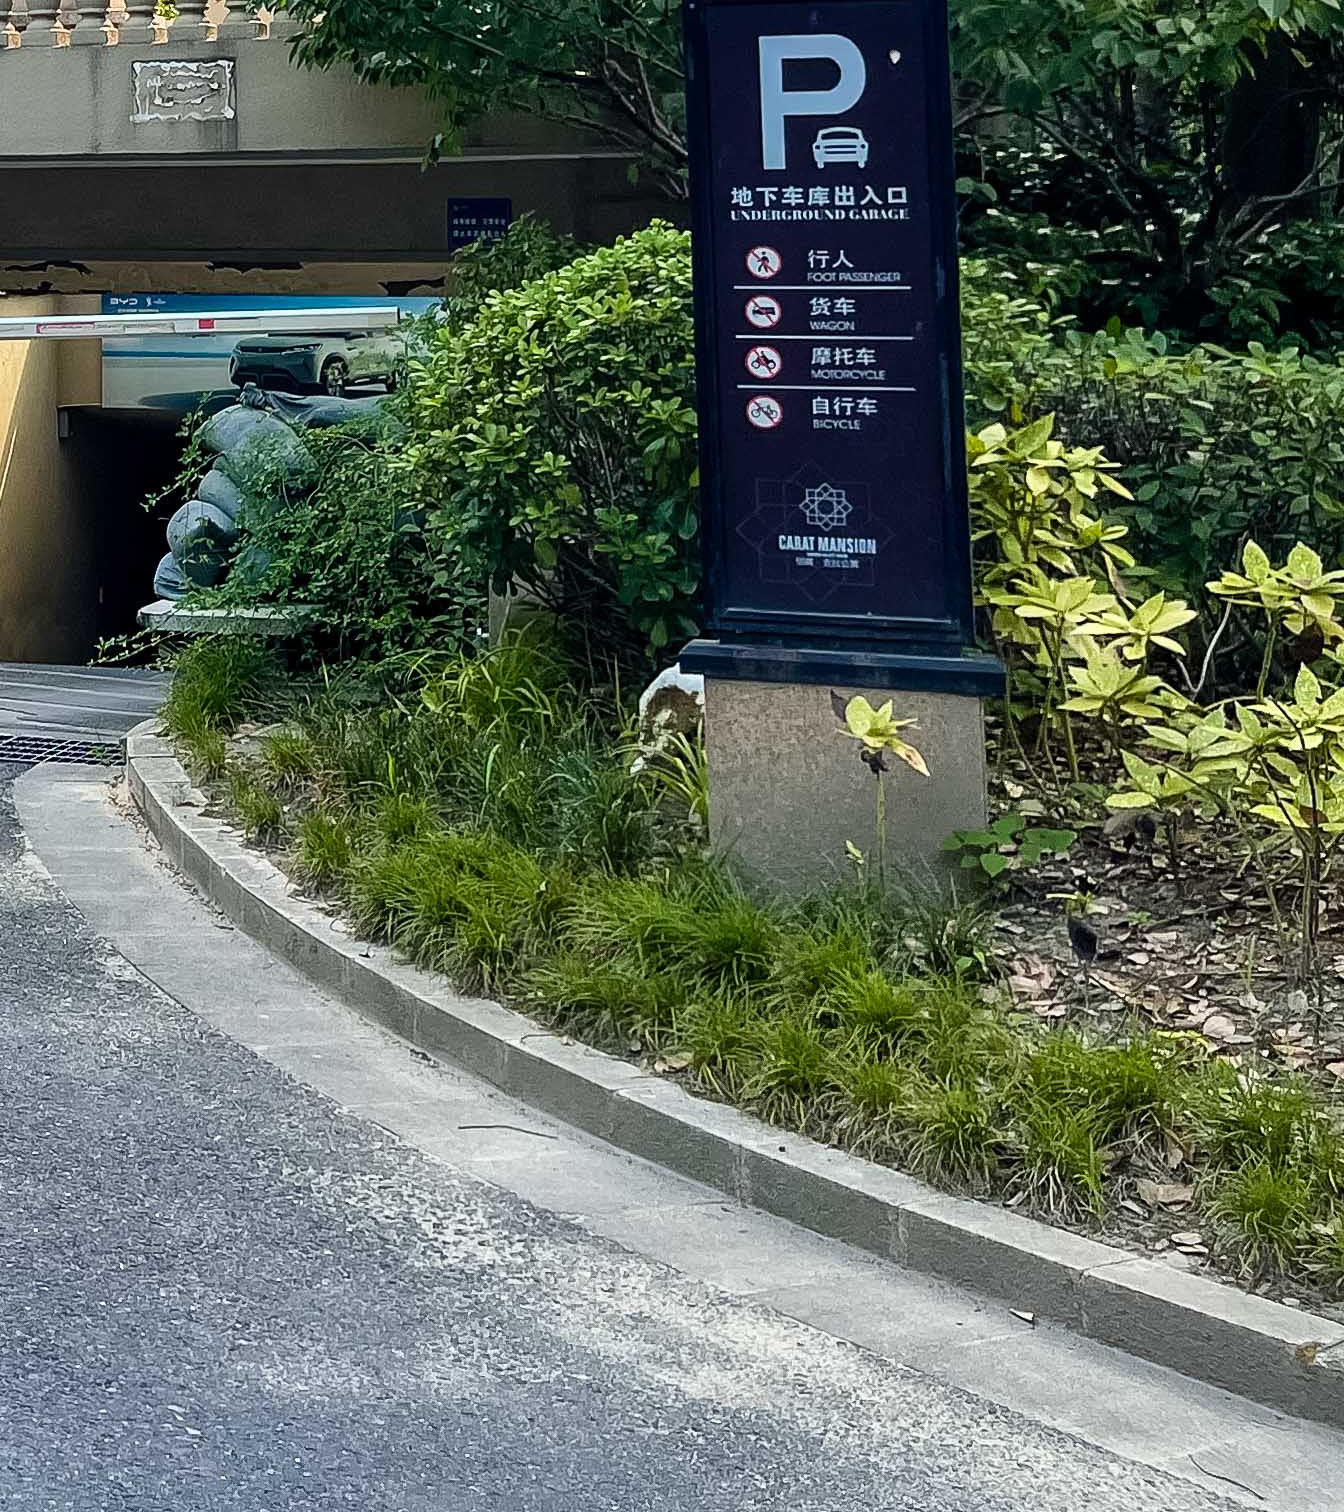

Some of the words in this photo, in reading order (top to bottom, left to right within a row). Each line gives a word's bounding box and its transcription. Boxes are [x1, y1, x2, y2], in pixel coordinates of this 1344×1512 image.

[758, 33, 866, 170] P
[730, 185, 908, 207] 地下车库出入口
[730, 208, 846, 222] UNDERGROUND
[848, 208, 910, 221] GARAGE
[807, 249, 854, 269] 行人
[807, 272, 837, 282] FOOT
[838, 272, 901, 282] PASSENGER
[110, 297, 138, 305] BYD
[809, 296, 856, 316] 货车
[810, 321, 855, 331] WAGON
[811, 347, 877, 366] 摩托车
[811, 369, 886, 381] MOTORCYCLE
[812, 396, 878, 416] 自行车
[813, 419, 861, 430] BICYCLE
[778, 535, 814, 552] CARAT
[817, 537, 877, 555] MANSION
